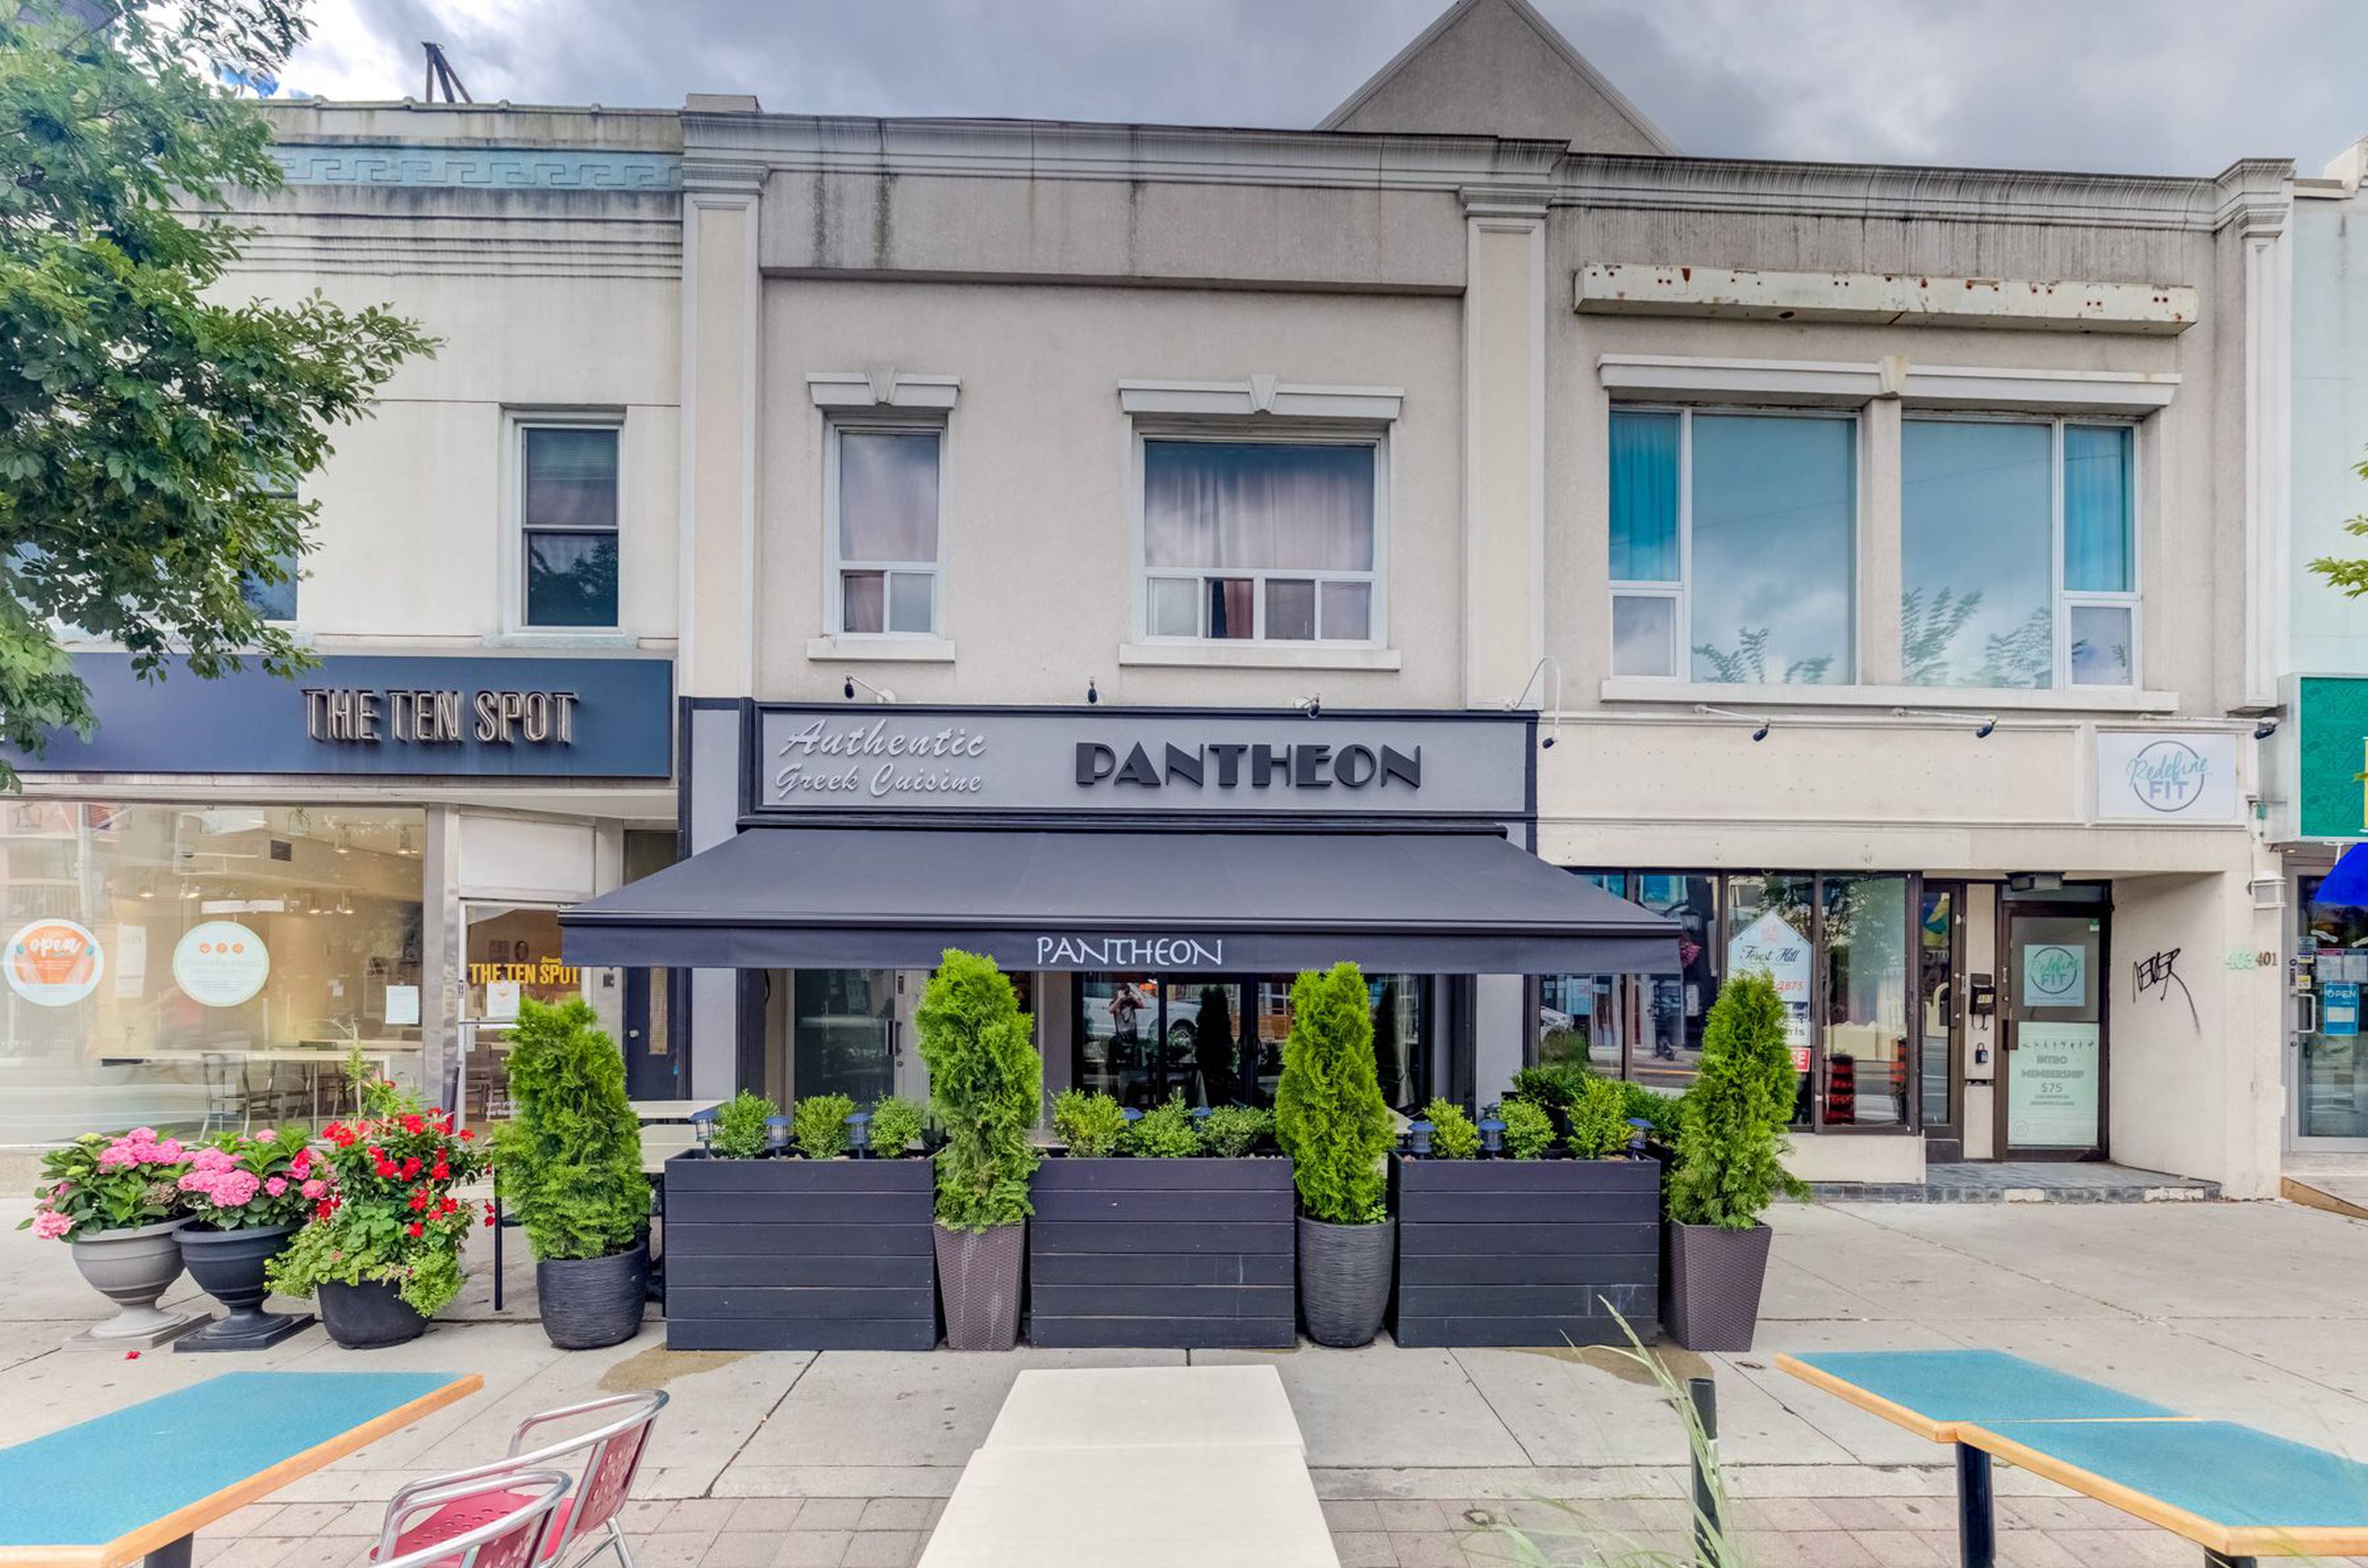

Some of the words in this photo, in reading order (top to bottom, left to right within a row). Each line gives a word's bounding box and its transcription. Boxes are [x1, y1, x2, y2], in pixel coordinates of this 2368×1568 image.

[301, 689, 380, 742] THE
[385, 689, 463, 742] TEN
[474, 689, 578, 744] SPOT
[779, 718, 987, 757] Authentic
[1075, 741, 1421, 787] PANTHEON
[2126, 750, 2209, 787] Redefine
[776, 763, 860, 799] Greek
[870, 763, 983, 797] Cuisine
[2149, 781, 2189, 800] FIT
[1037, 937, 1222, 965] PANTHEON
[2256, 951, 2278, 966] 401
[469, 963, 501, 984] THE
[503, 963, 535, 984] TEN
[2041, 974, 2067, 986] FIT
[2327, 990, 2357, 998] OPEN
[2037, 1055, 2068, 1065] INTRO
[2041, 1083, 2062, 1093] $75
